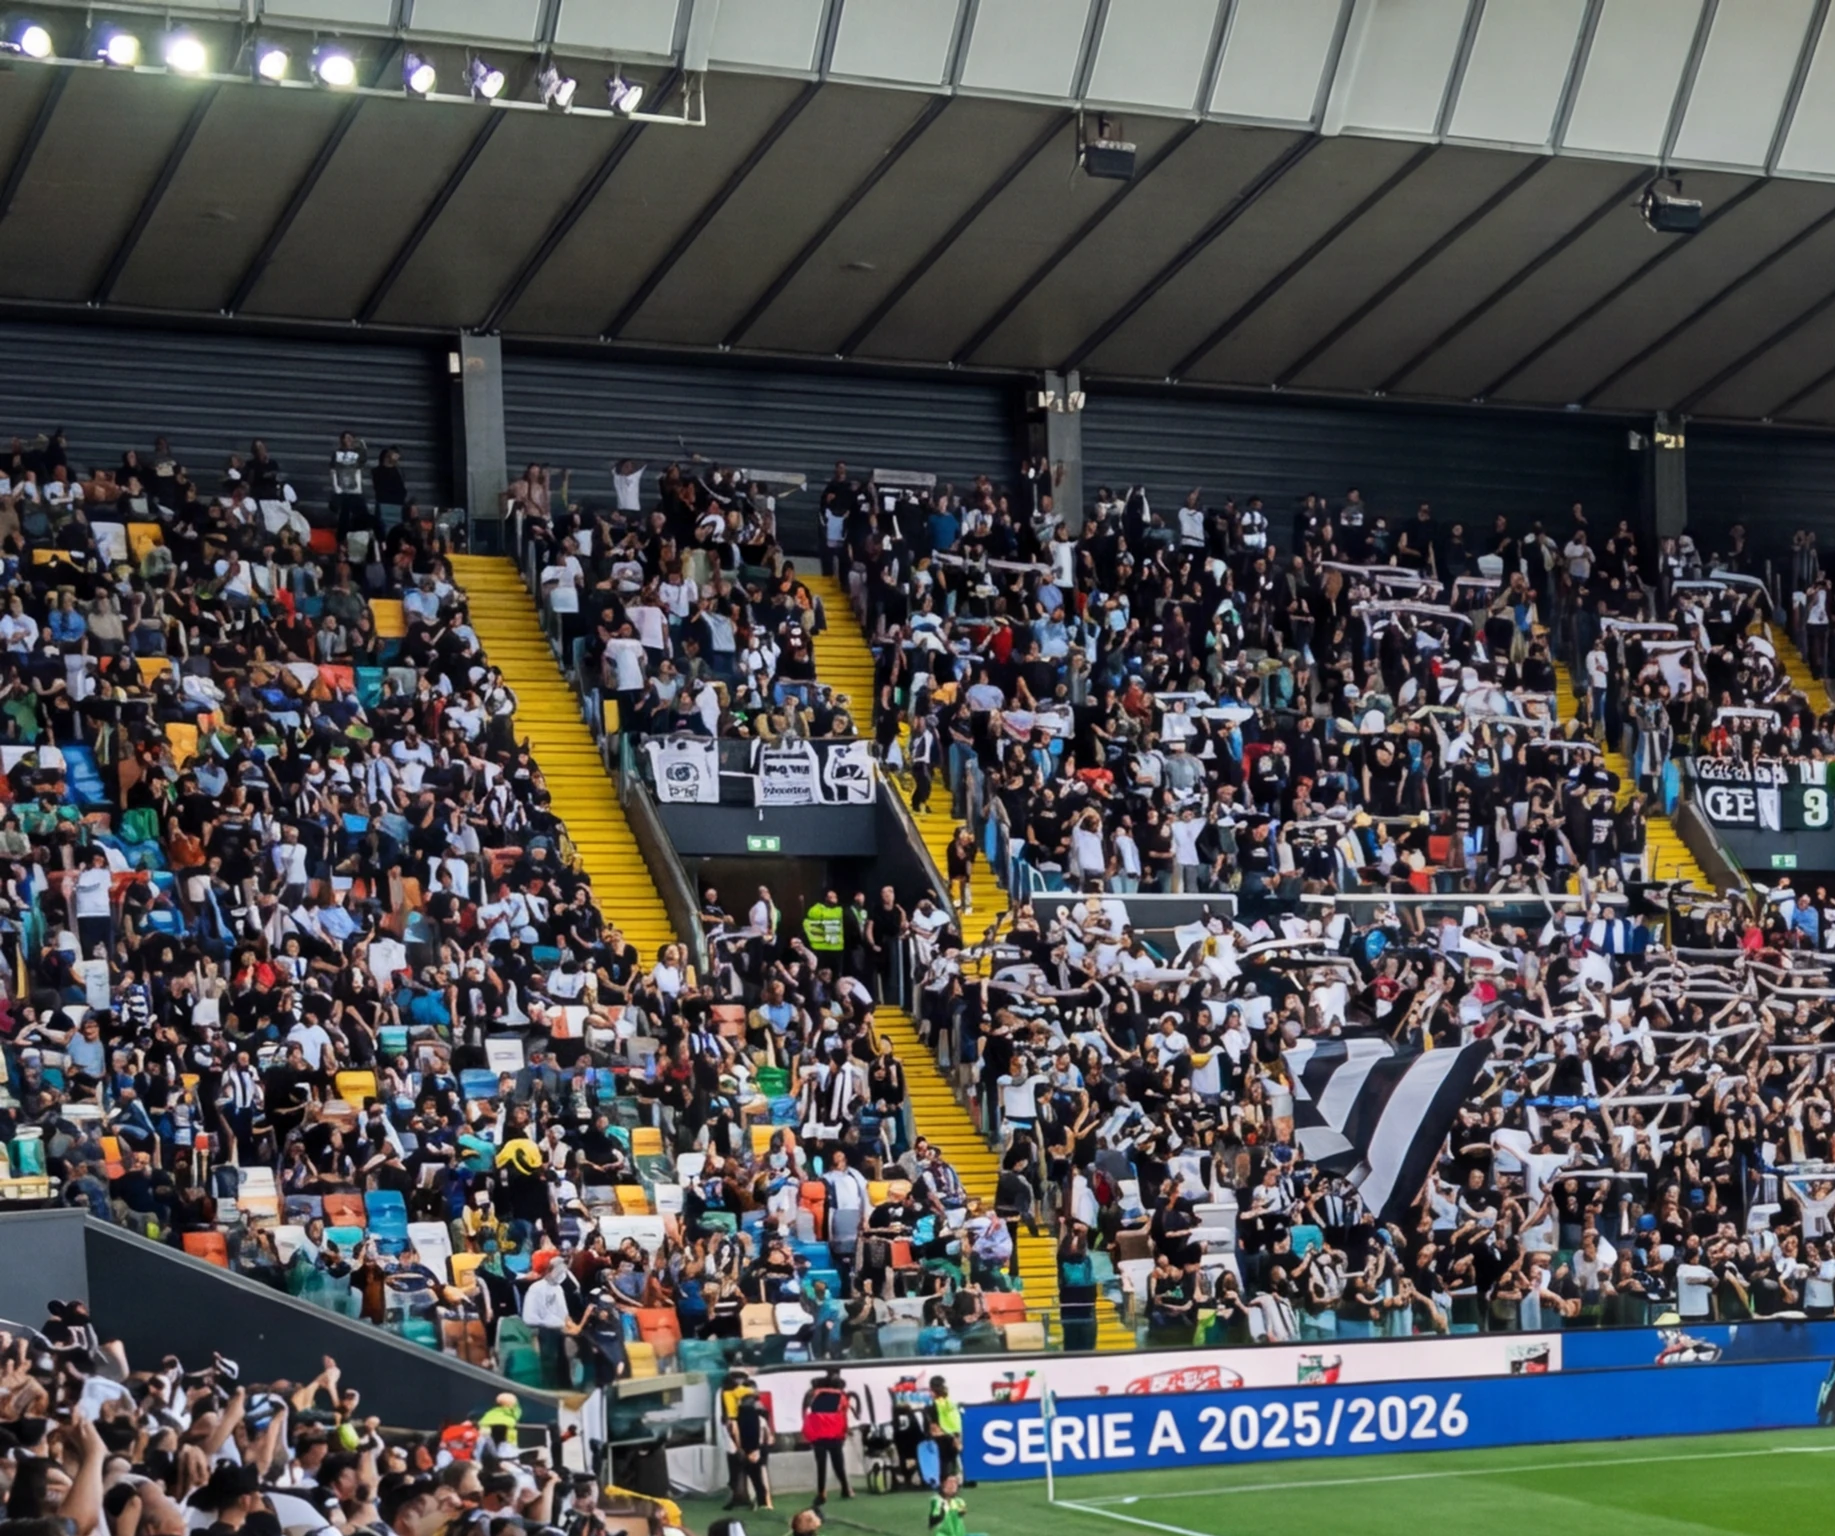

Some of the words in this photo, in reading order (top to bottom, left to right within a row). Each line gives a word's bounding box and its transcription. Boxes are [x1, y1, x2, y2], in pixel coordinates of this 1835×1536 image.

[982, 1413, 1135, 1466] SERIE
[1148, 1410, 1184, 1456] A
[1198, 1393, 1468, 1452] 2025/2026
